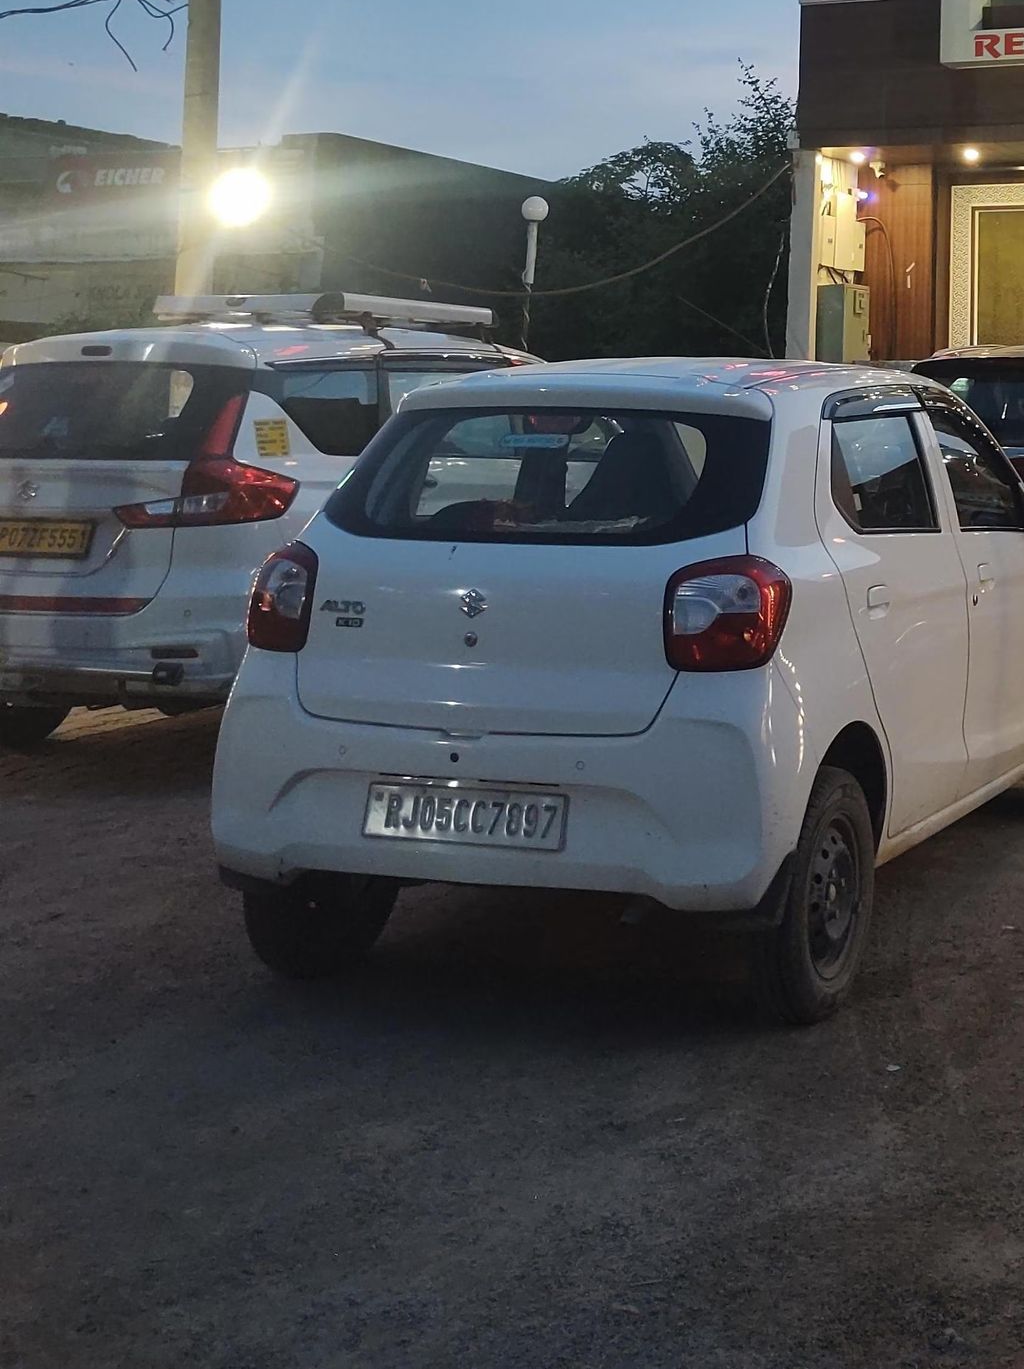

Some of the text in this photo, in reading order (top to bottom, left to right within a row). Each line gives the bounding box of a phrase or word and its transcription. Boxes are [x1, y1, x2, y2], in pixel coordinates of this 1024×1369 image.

[94, 167, 166, 186] EICHER
[319, 599, 367, 615] ALTO
[384, 793, 558, 839] RJ05CC7897
